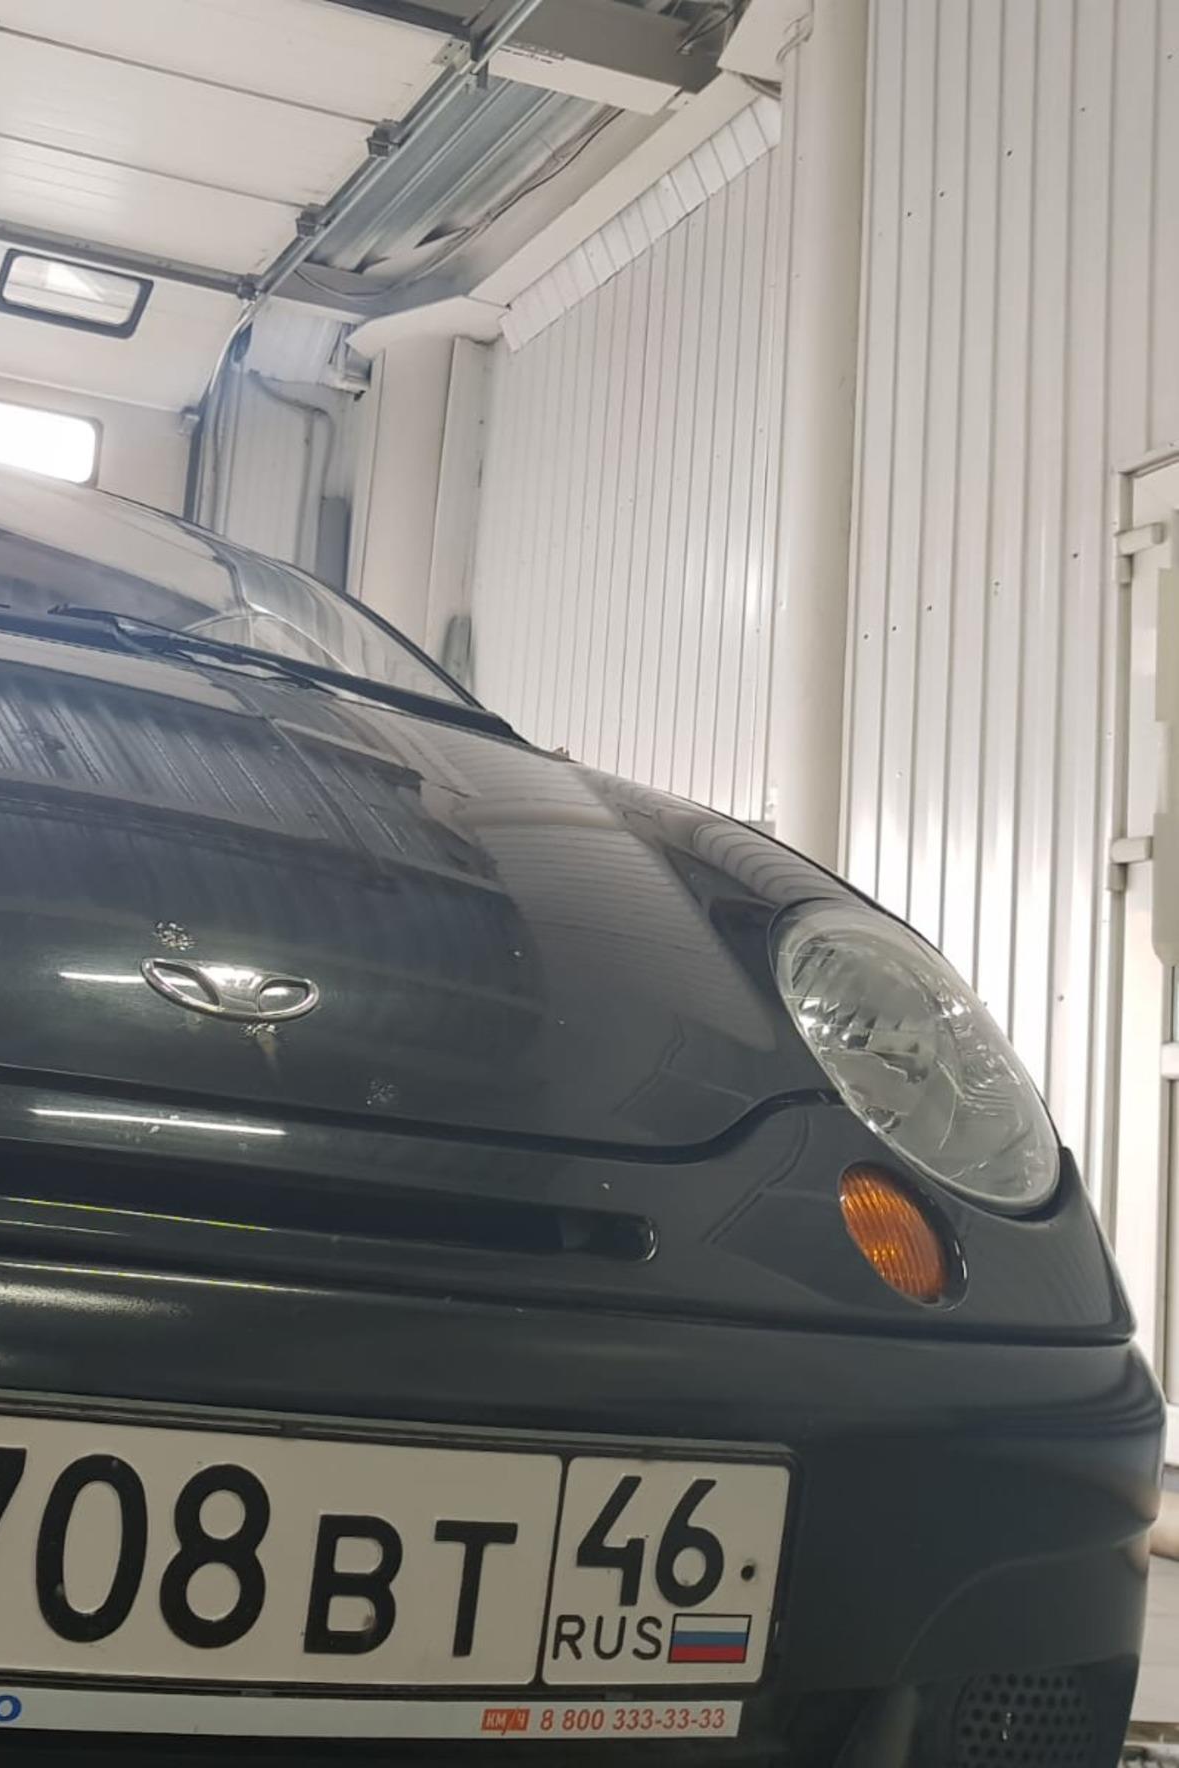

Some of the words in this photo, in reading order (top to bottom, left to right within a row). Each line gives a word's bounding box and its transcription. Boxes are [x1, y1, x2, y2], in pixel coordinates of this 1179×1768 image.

[576, 1475, 725, 1608] 46
[551, 1614, 663, 1661] RUS
[540, 1709, 554, 1731] 8
[561, 1708, 605, 1731] 800
[612, 1707, 726, 1731] 333-33-33
